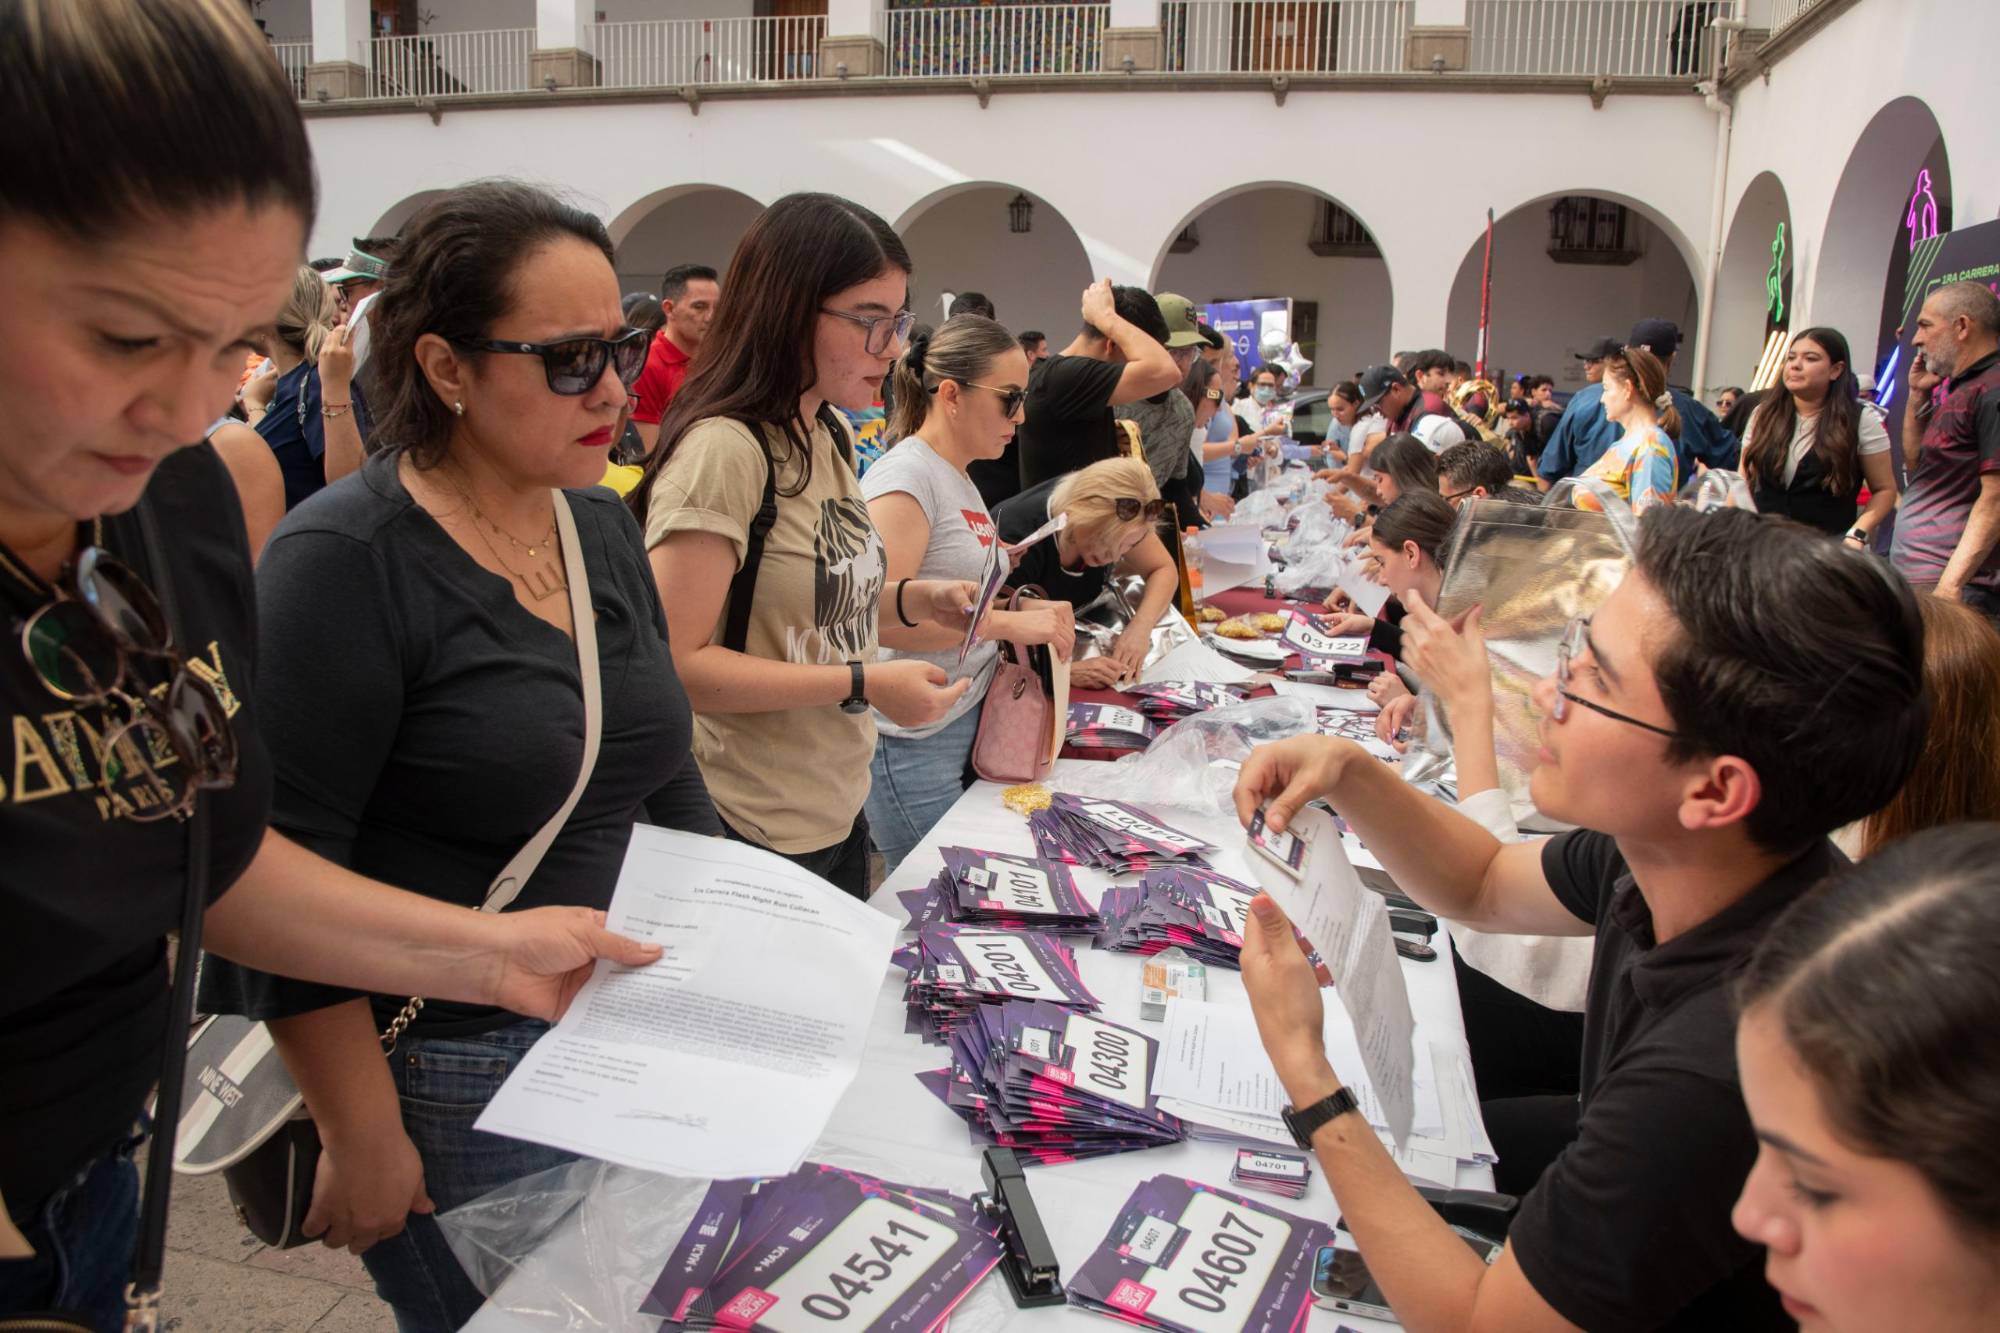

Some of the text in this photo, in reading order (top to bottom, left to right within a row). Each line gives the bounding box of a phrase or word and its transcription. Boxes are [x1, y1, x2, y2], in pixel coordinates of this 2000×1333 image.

[1942, 263, 1999, 284] 1RA CARRERA
[1301, 632, 1361, 652] 03122
[1008, 870, 1044, 909] 04101
[976, 943, 1040, 992] 04201
[1089, 1030, 1130, 1091] 04300
[197, 1065, 244, 1109] NINE WEST
[1255, 1160, 1288, 1171] 04701
[801, 1219, 930, 1321] 04541
[1178, 1211, 1265, 1314] 04607
